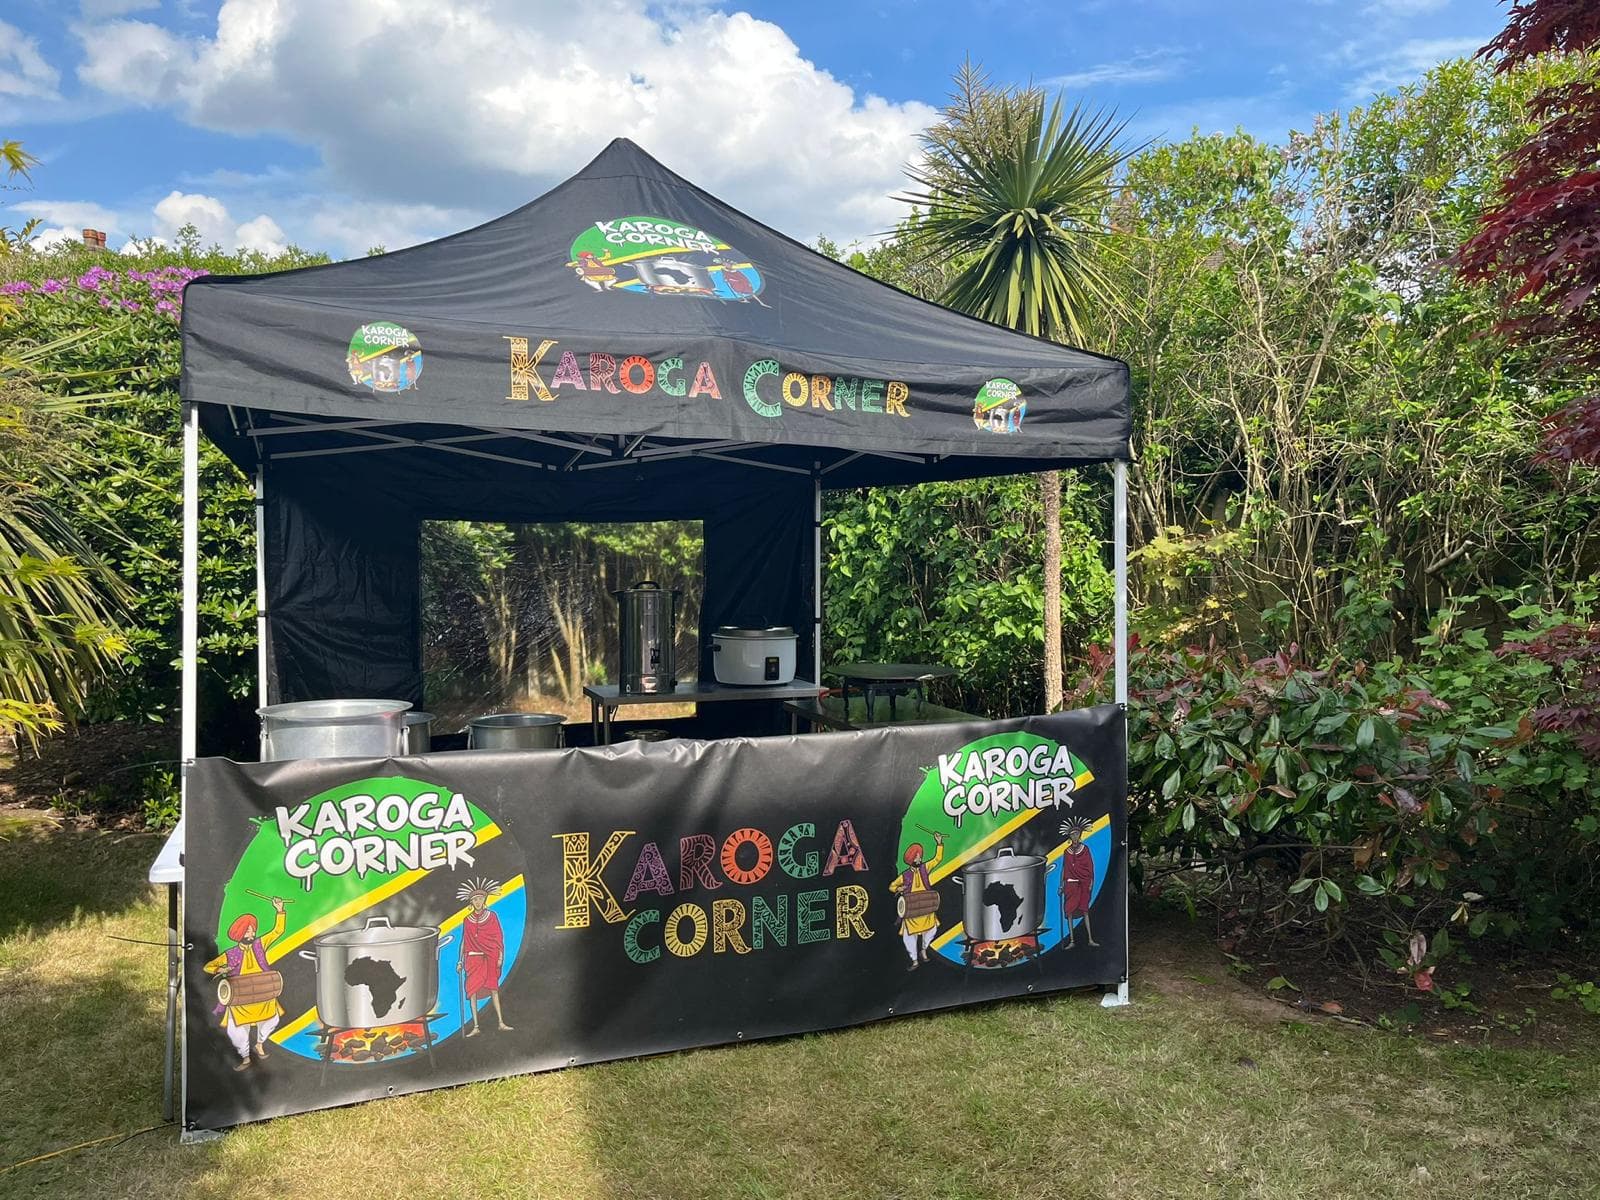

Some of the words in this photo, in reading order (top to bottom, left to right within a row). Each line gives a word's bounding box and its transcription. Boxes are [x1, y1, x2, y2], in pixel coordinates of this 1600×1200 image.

[595, 221, 712, 243] KAROGA
[606, 232, 719, 255] CORNER
[361, 325, 408, 337] KAROGA
[364, 335, 409, 347] CORNER
[502, 336, 723, 402] KAROGA
[743, 359, 911, 418] CORNER
[986, 381, 1017, 391] KAROGA
[986, 389, 1017, 400] CORNER
[937, 745, 1074, 790] KAROGA
[275, 793, 474, 846] KAROGA
[943, 777, 1076, 828] CORNER
[284, 830, 476, 891] CORNER
[551, 819, 869, 929] KAROGA
[623, 885, 875, 964] CORNER
